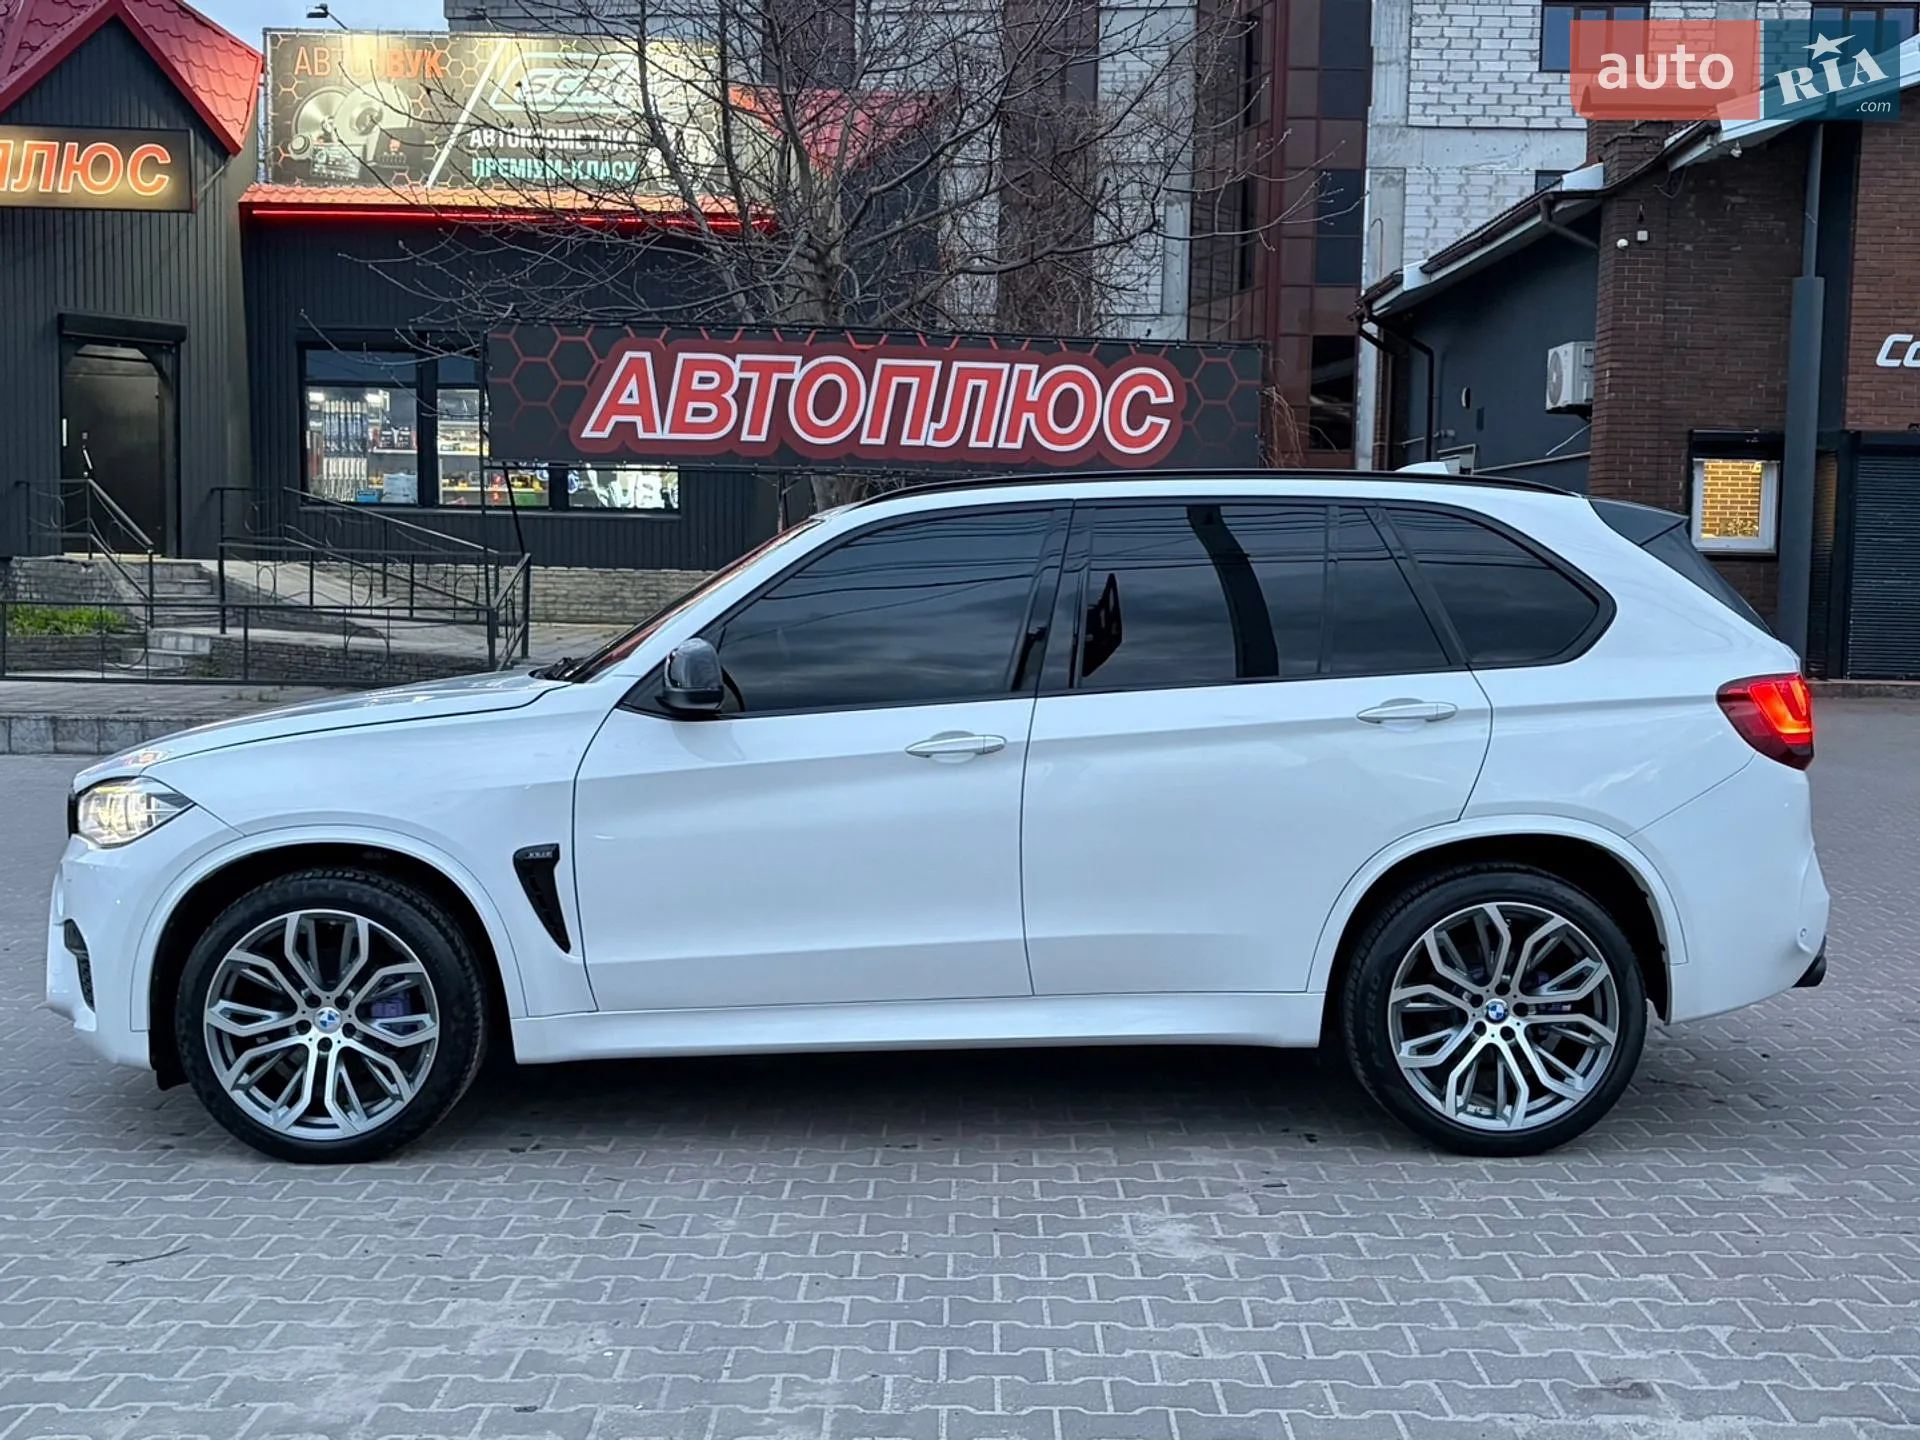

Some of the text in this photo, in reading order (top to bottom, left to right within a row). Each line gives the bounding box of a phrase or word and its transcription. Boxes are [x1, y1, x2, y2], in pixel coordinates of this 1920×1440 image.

[469, 127, 639, 150] АВТОКОСМЕТИКА
[471, 157, 638, 181] ПРЕМІУМ-КЛАСУ
[581, 351, 1174, 454] АВТОПЛЮС
